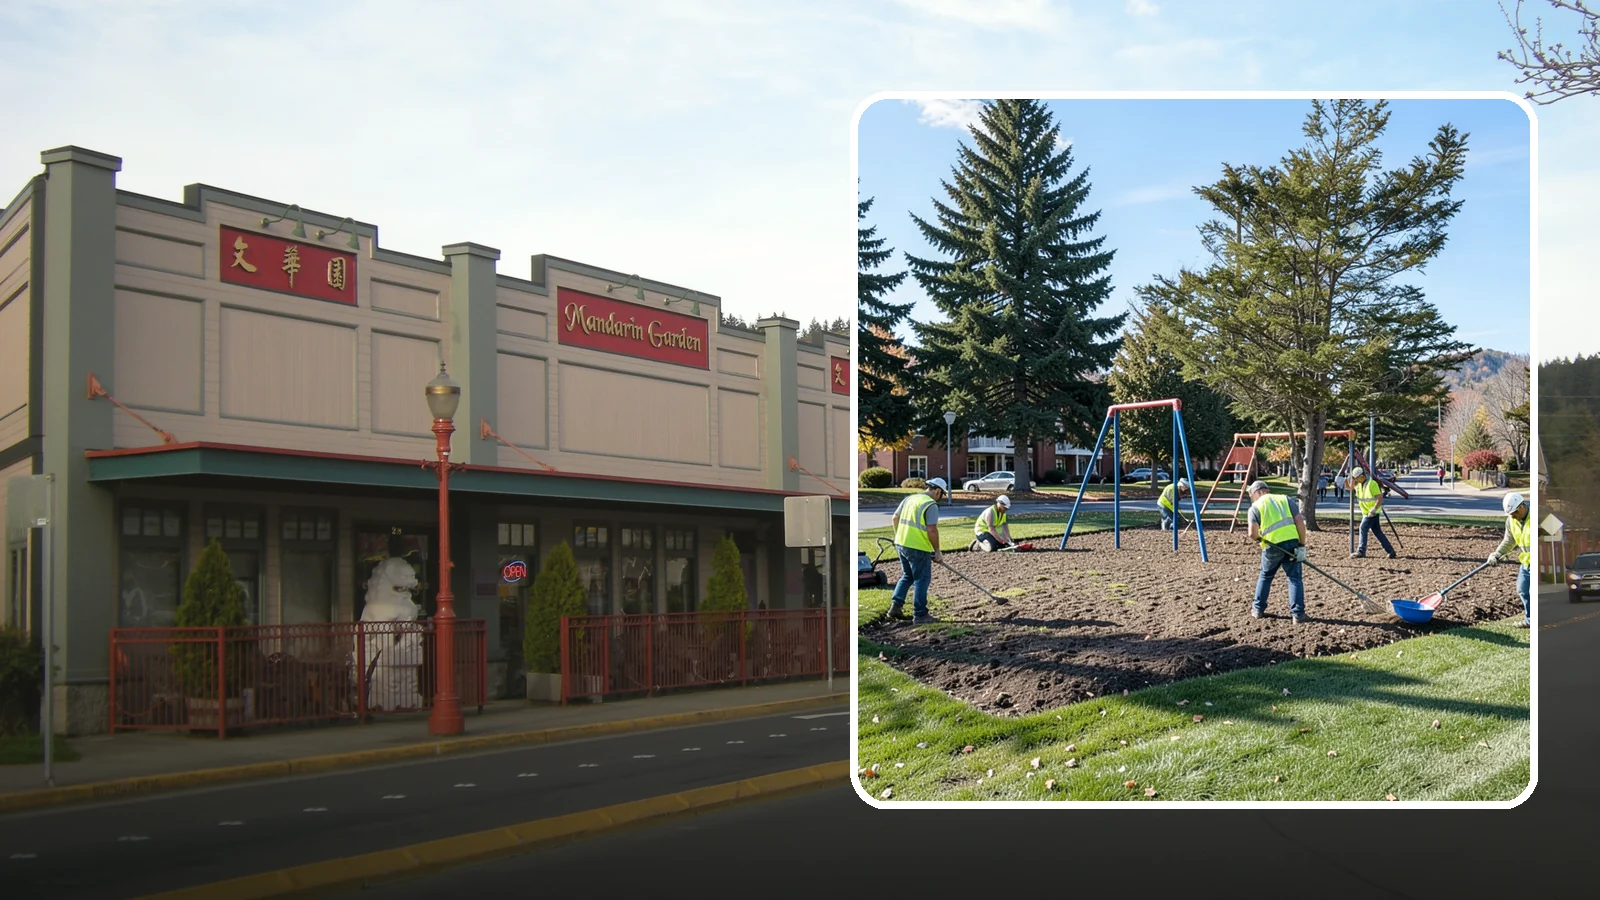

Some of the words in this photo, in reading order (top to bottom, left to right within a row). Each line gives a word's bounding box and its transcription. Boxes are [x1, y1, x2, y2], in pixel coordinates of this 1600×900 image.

[231, 236, 346, 291] 文華園
[564, 302, 644, 341] Mandarin
[647, 320, 702, 352] Garden
[503, 565, 527, 578] OPEN
